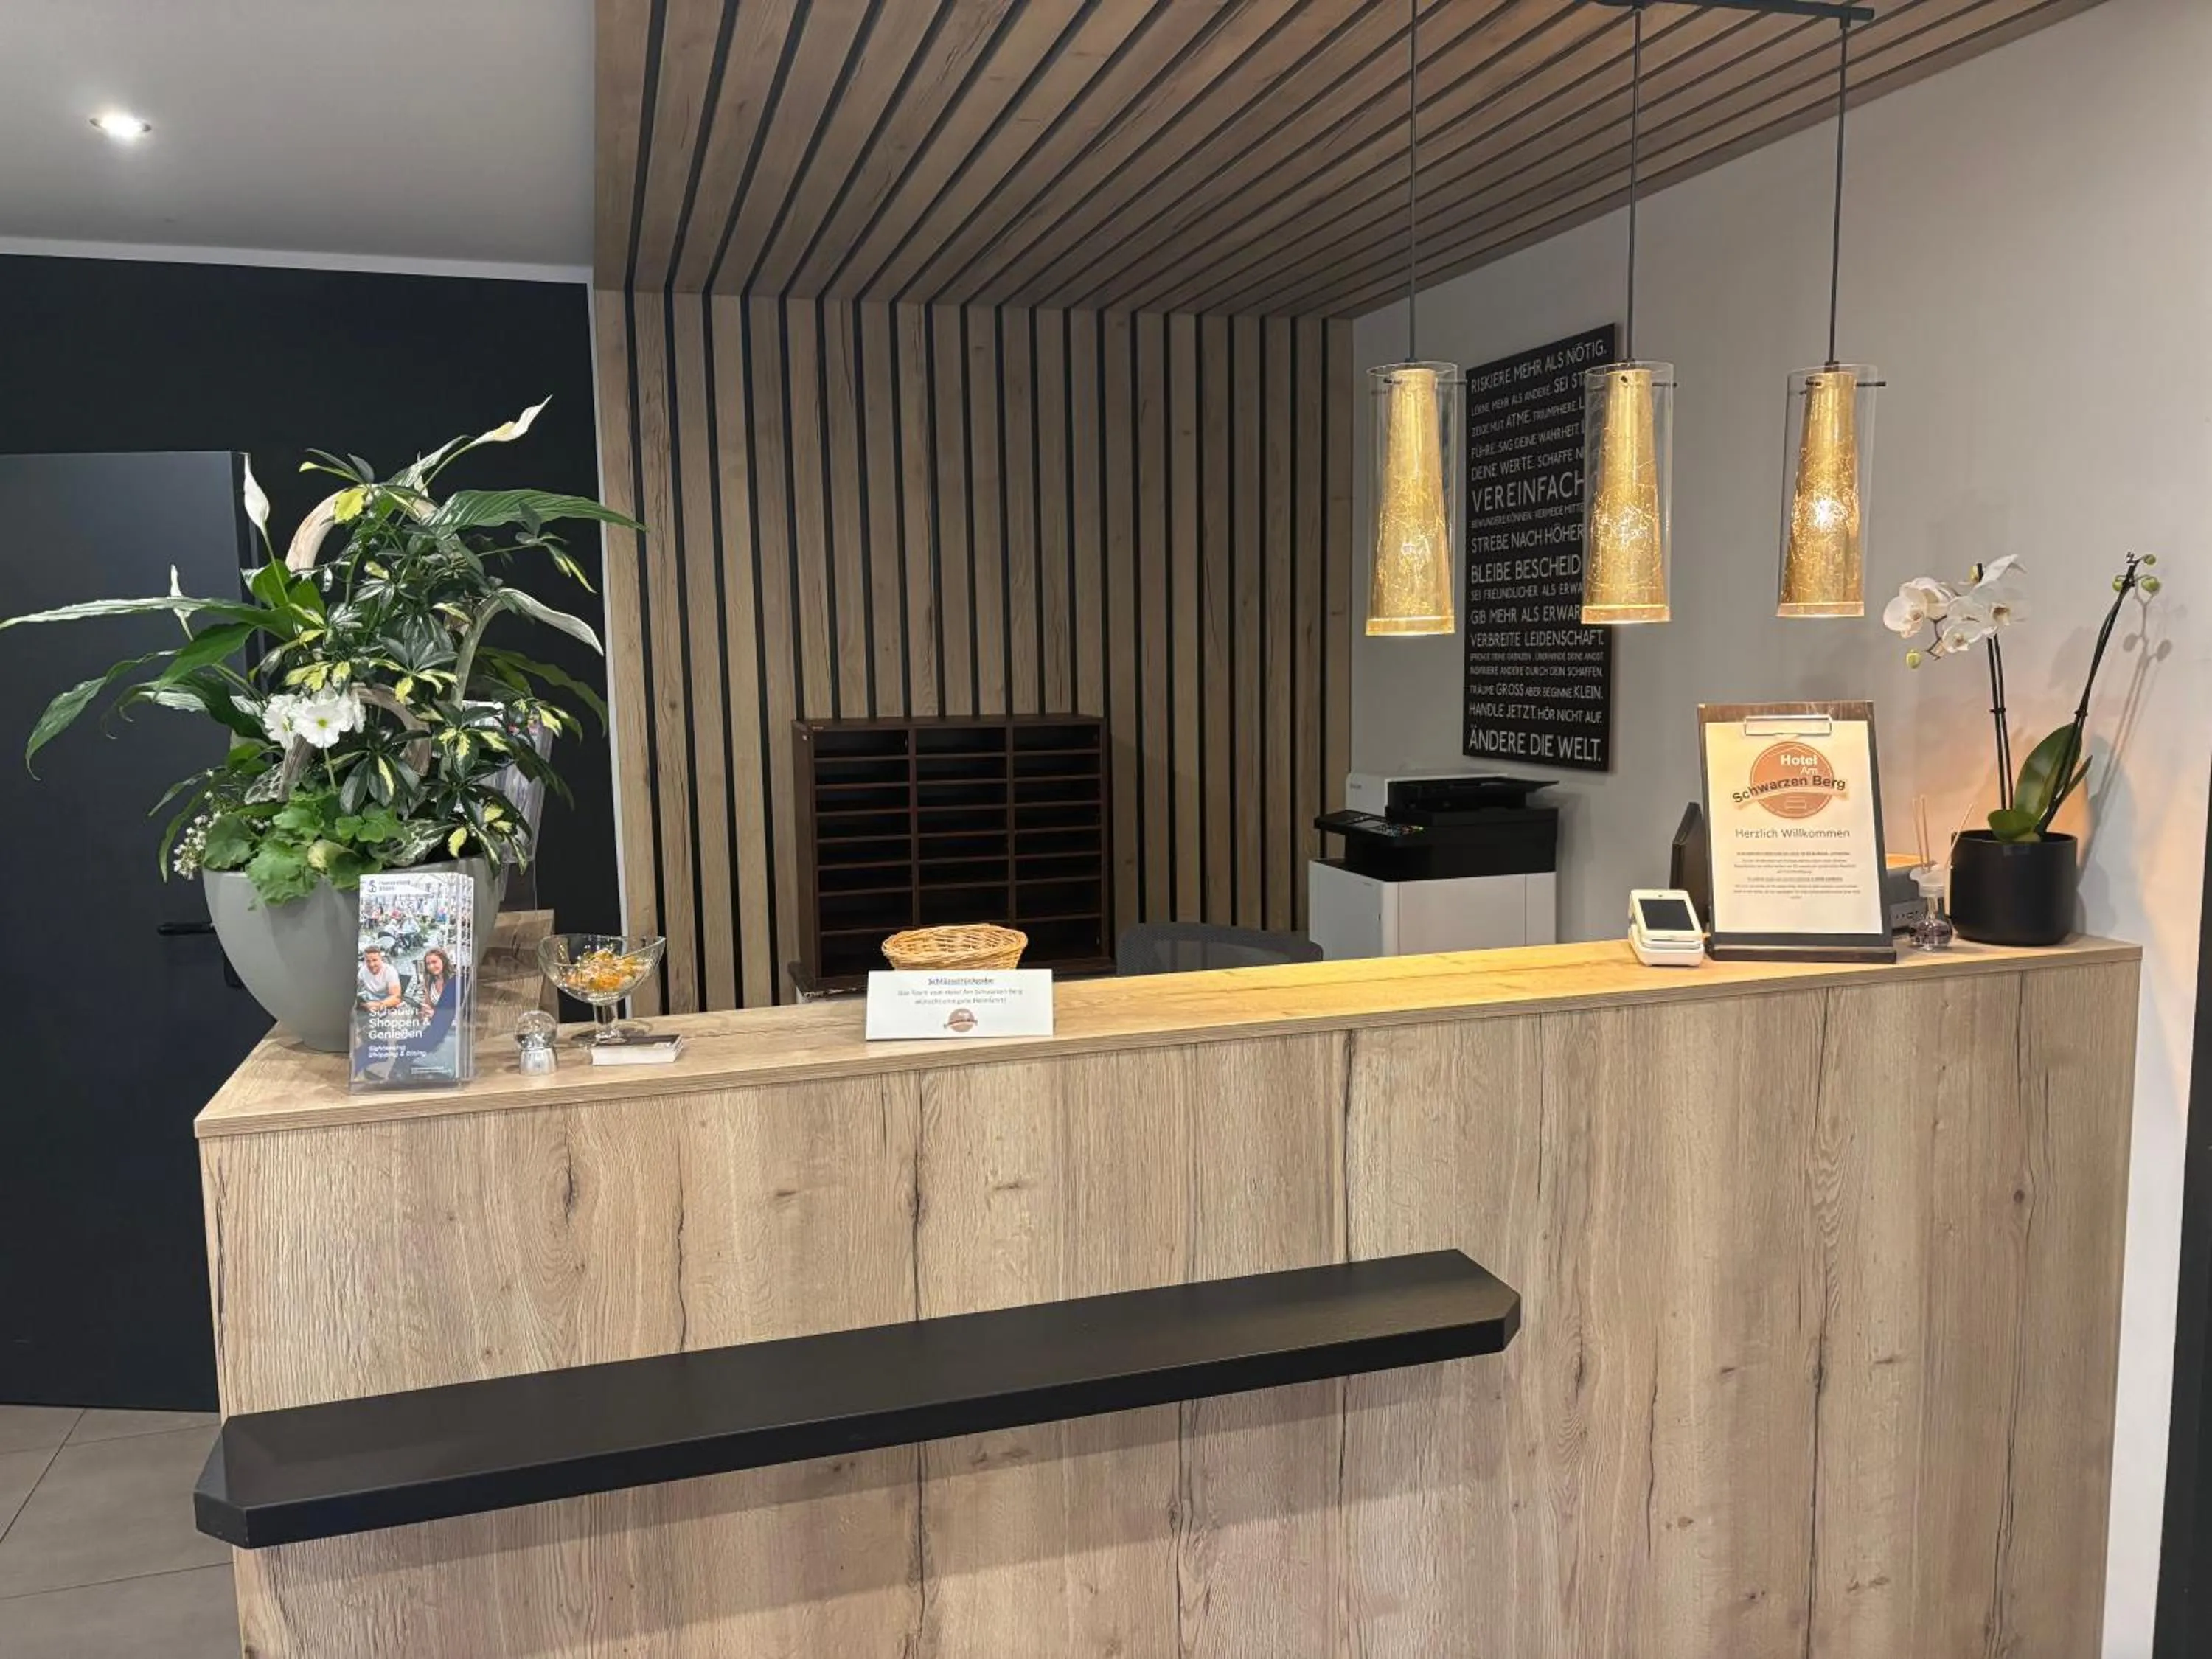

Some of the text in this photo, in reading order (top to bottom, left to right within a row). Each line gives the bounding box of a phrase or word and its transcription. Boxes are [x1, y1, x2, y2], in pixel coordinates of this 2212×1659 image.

[1471, 339, 1607, 394] RISKIERE MEHR ALS NÖTIG.
[1492, 397, 1509, 411] MEHR
[1512, 393, 1522, 405] ALS
[1554, 377, 1569, 394] SEI
[1498, 439, 1513, 453] SAG
[1514, 433, 1537, 449] DEINE
[1471, 462, 1498, 481] DEINE
[1537, 448, 1573, 468] SCHAFFE
[1471, 533, 1509, 554] STREBE
[1511, 527, 1543, 549] NACH
[1471, 554, 1582, 585] BLEIBE BESCHEID
[1542, 583, 1557, 596] ALS
[1489, 606, 1517, 623] MEHR
[1521, 605, 1539, 622] ALS
[1470, 630, 1604, 647] VERBREITE LEIDENSCHAFT.
[1495, 682, 1524, 697] GROSS
[1573, 685, 1604, 700] KLEIN.
[1469, 702, 1505, 717] HANDLE
[1537, 706, 1555, 720] HÖR
[1557, 709, 1584, 723] NICHT
[1585, 711, 1602, 723] AUF.
[1469, 724, 1601, 762] ÄNDERE DIE WELT.
[1781, 755, 1817, 765] Hotel
[1800, 766, 1818, 775] Am
[1732, 775, 1846, 803] Schwarzen Berg
[1735, 829, 1850, 838] Herzlich Willkommen
[369, 1018, 419, 1029] Shoppen
[369, 1029, 422, 1039] Genießen
